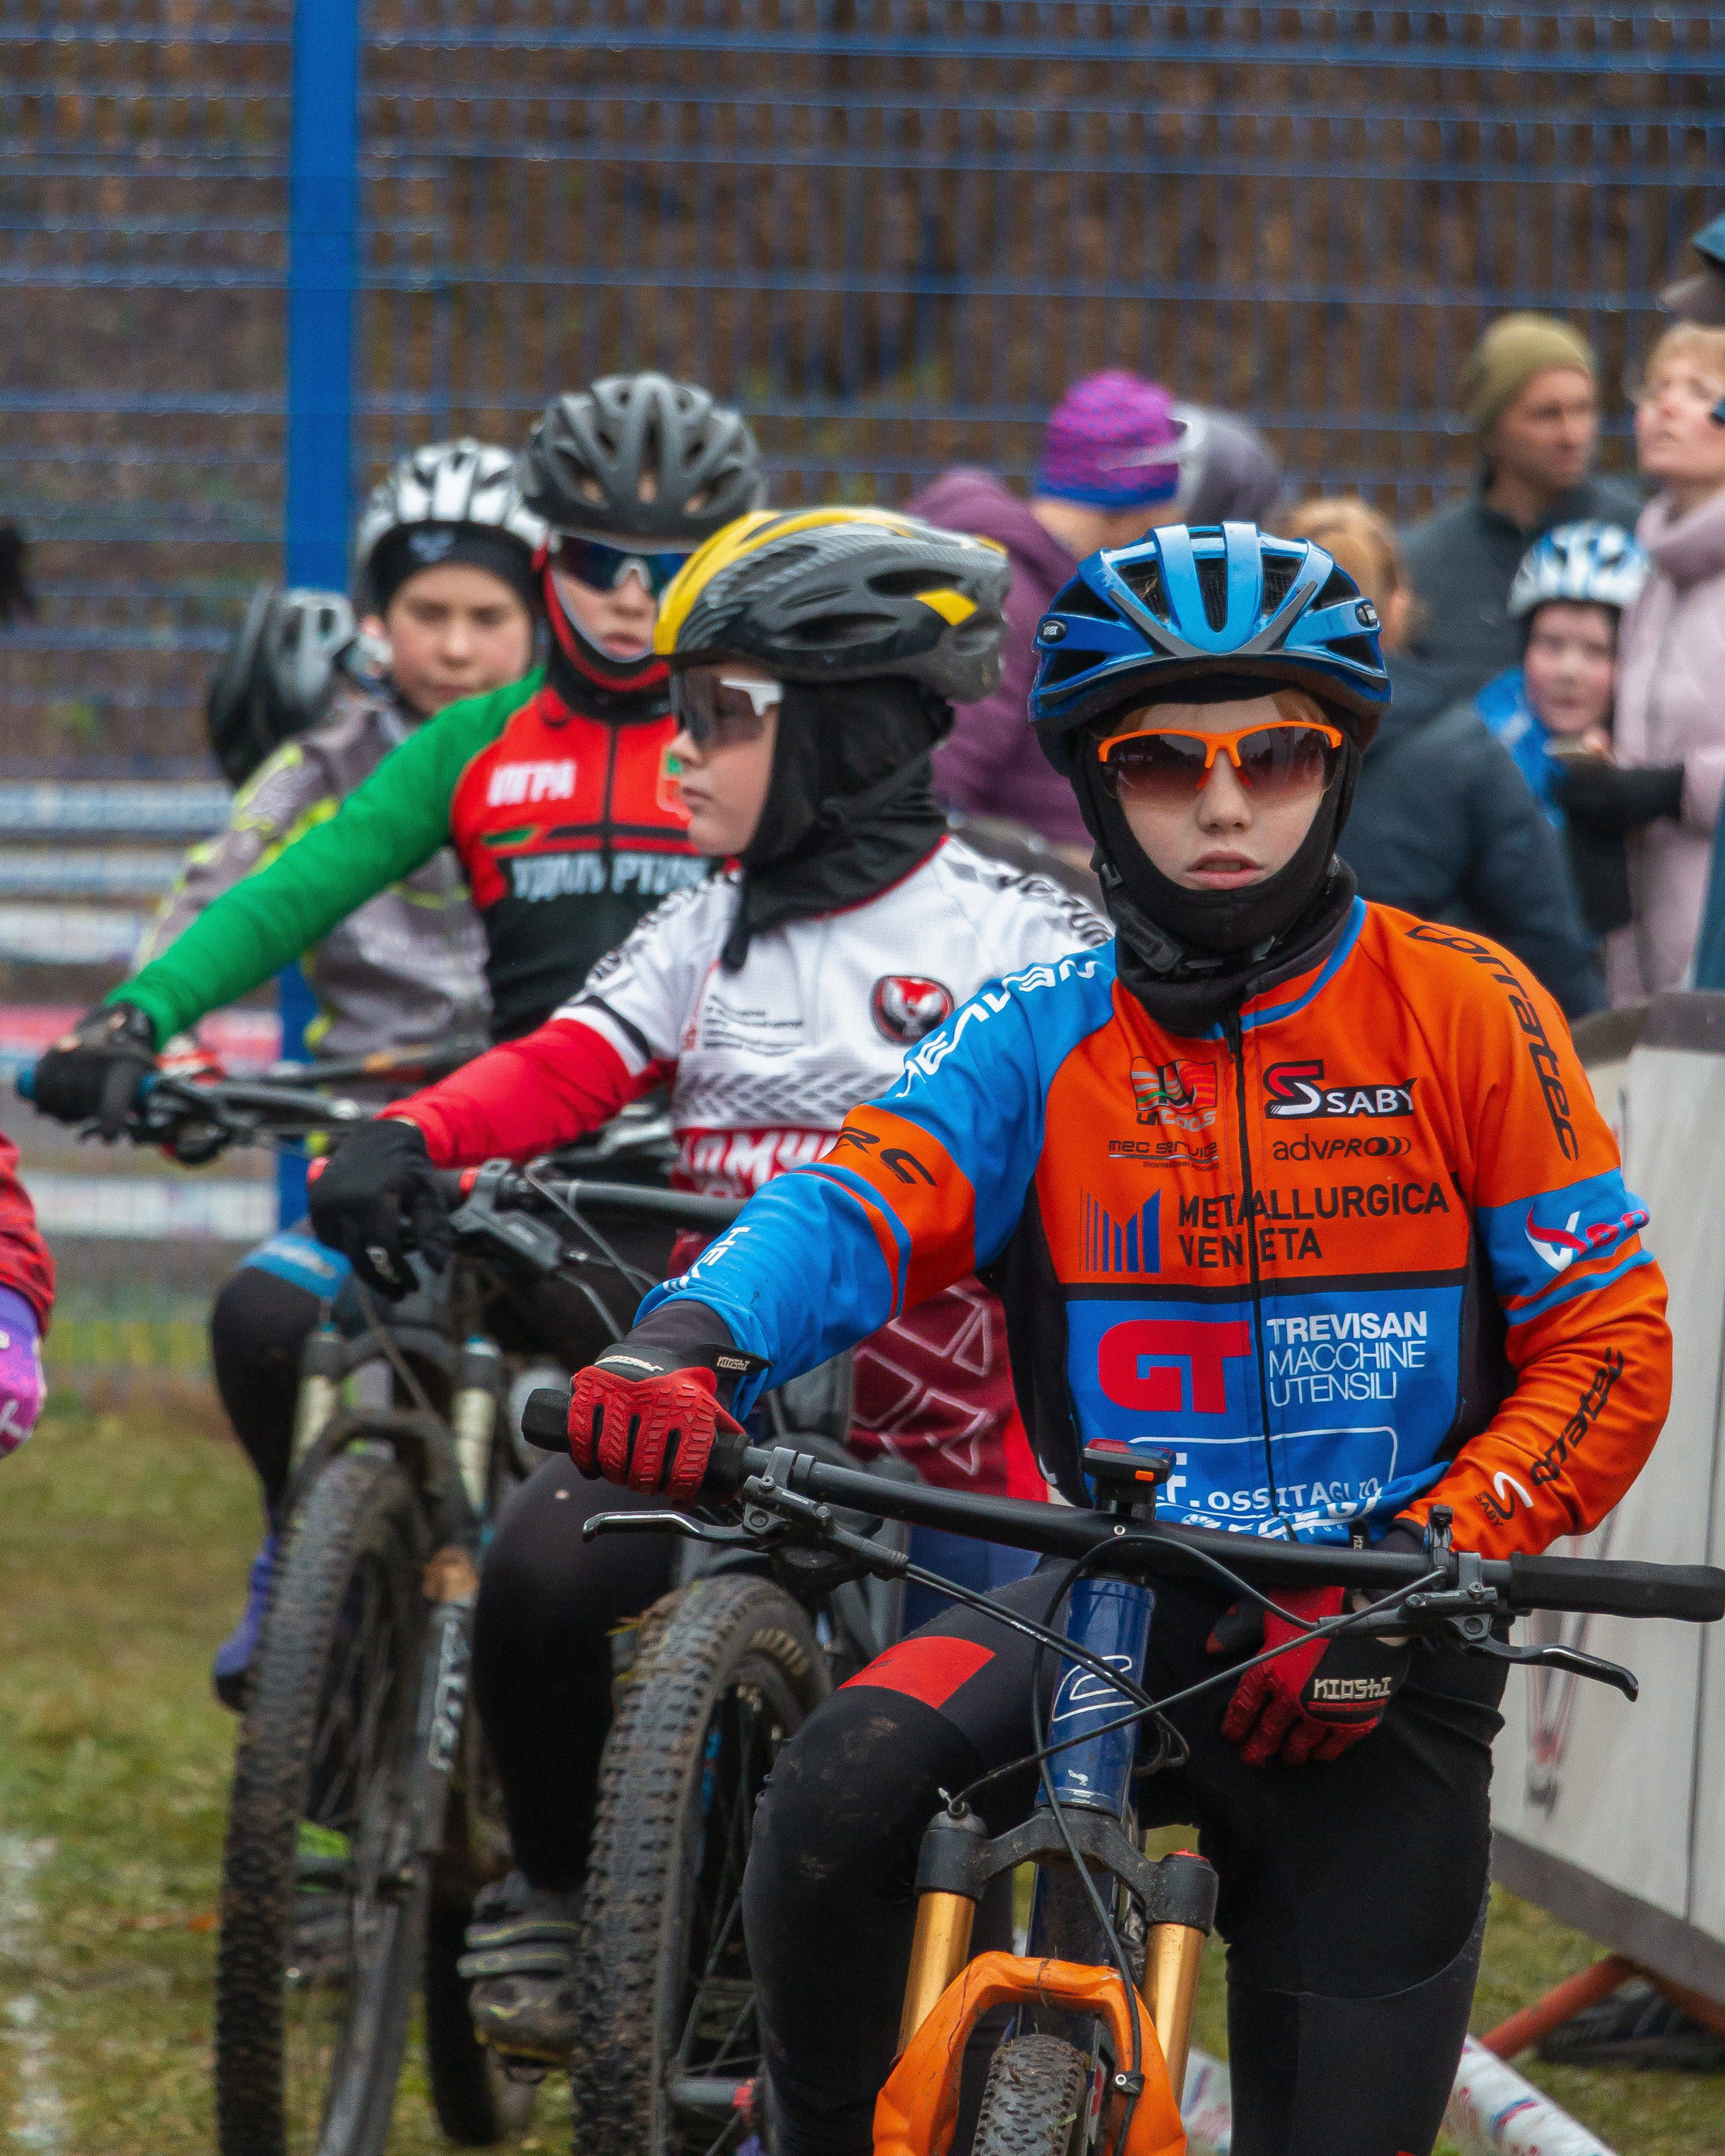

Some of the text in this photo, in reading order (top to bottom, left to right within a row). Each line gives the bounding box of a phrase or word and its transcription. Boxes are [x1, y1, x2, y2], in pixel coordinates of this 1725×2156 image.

[1108, 1140, 1150, 1153] mec
[1179, 1182, 1449, 1229] METALLURGICA
[1179, 1227, 1323, 1268] VENETA
[1266, 1311, 1427, 1345] TREVISAN
[1098, 1319, 1251, 1414] GT
[1269, 1340, 1426, 1378] MACCHINE
[1269, 1371, 1397, 1407] UTENSILI
[1313, 1677, 1392, 1699] KIOSHI
